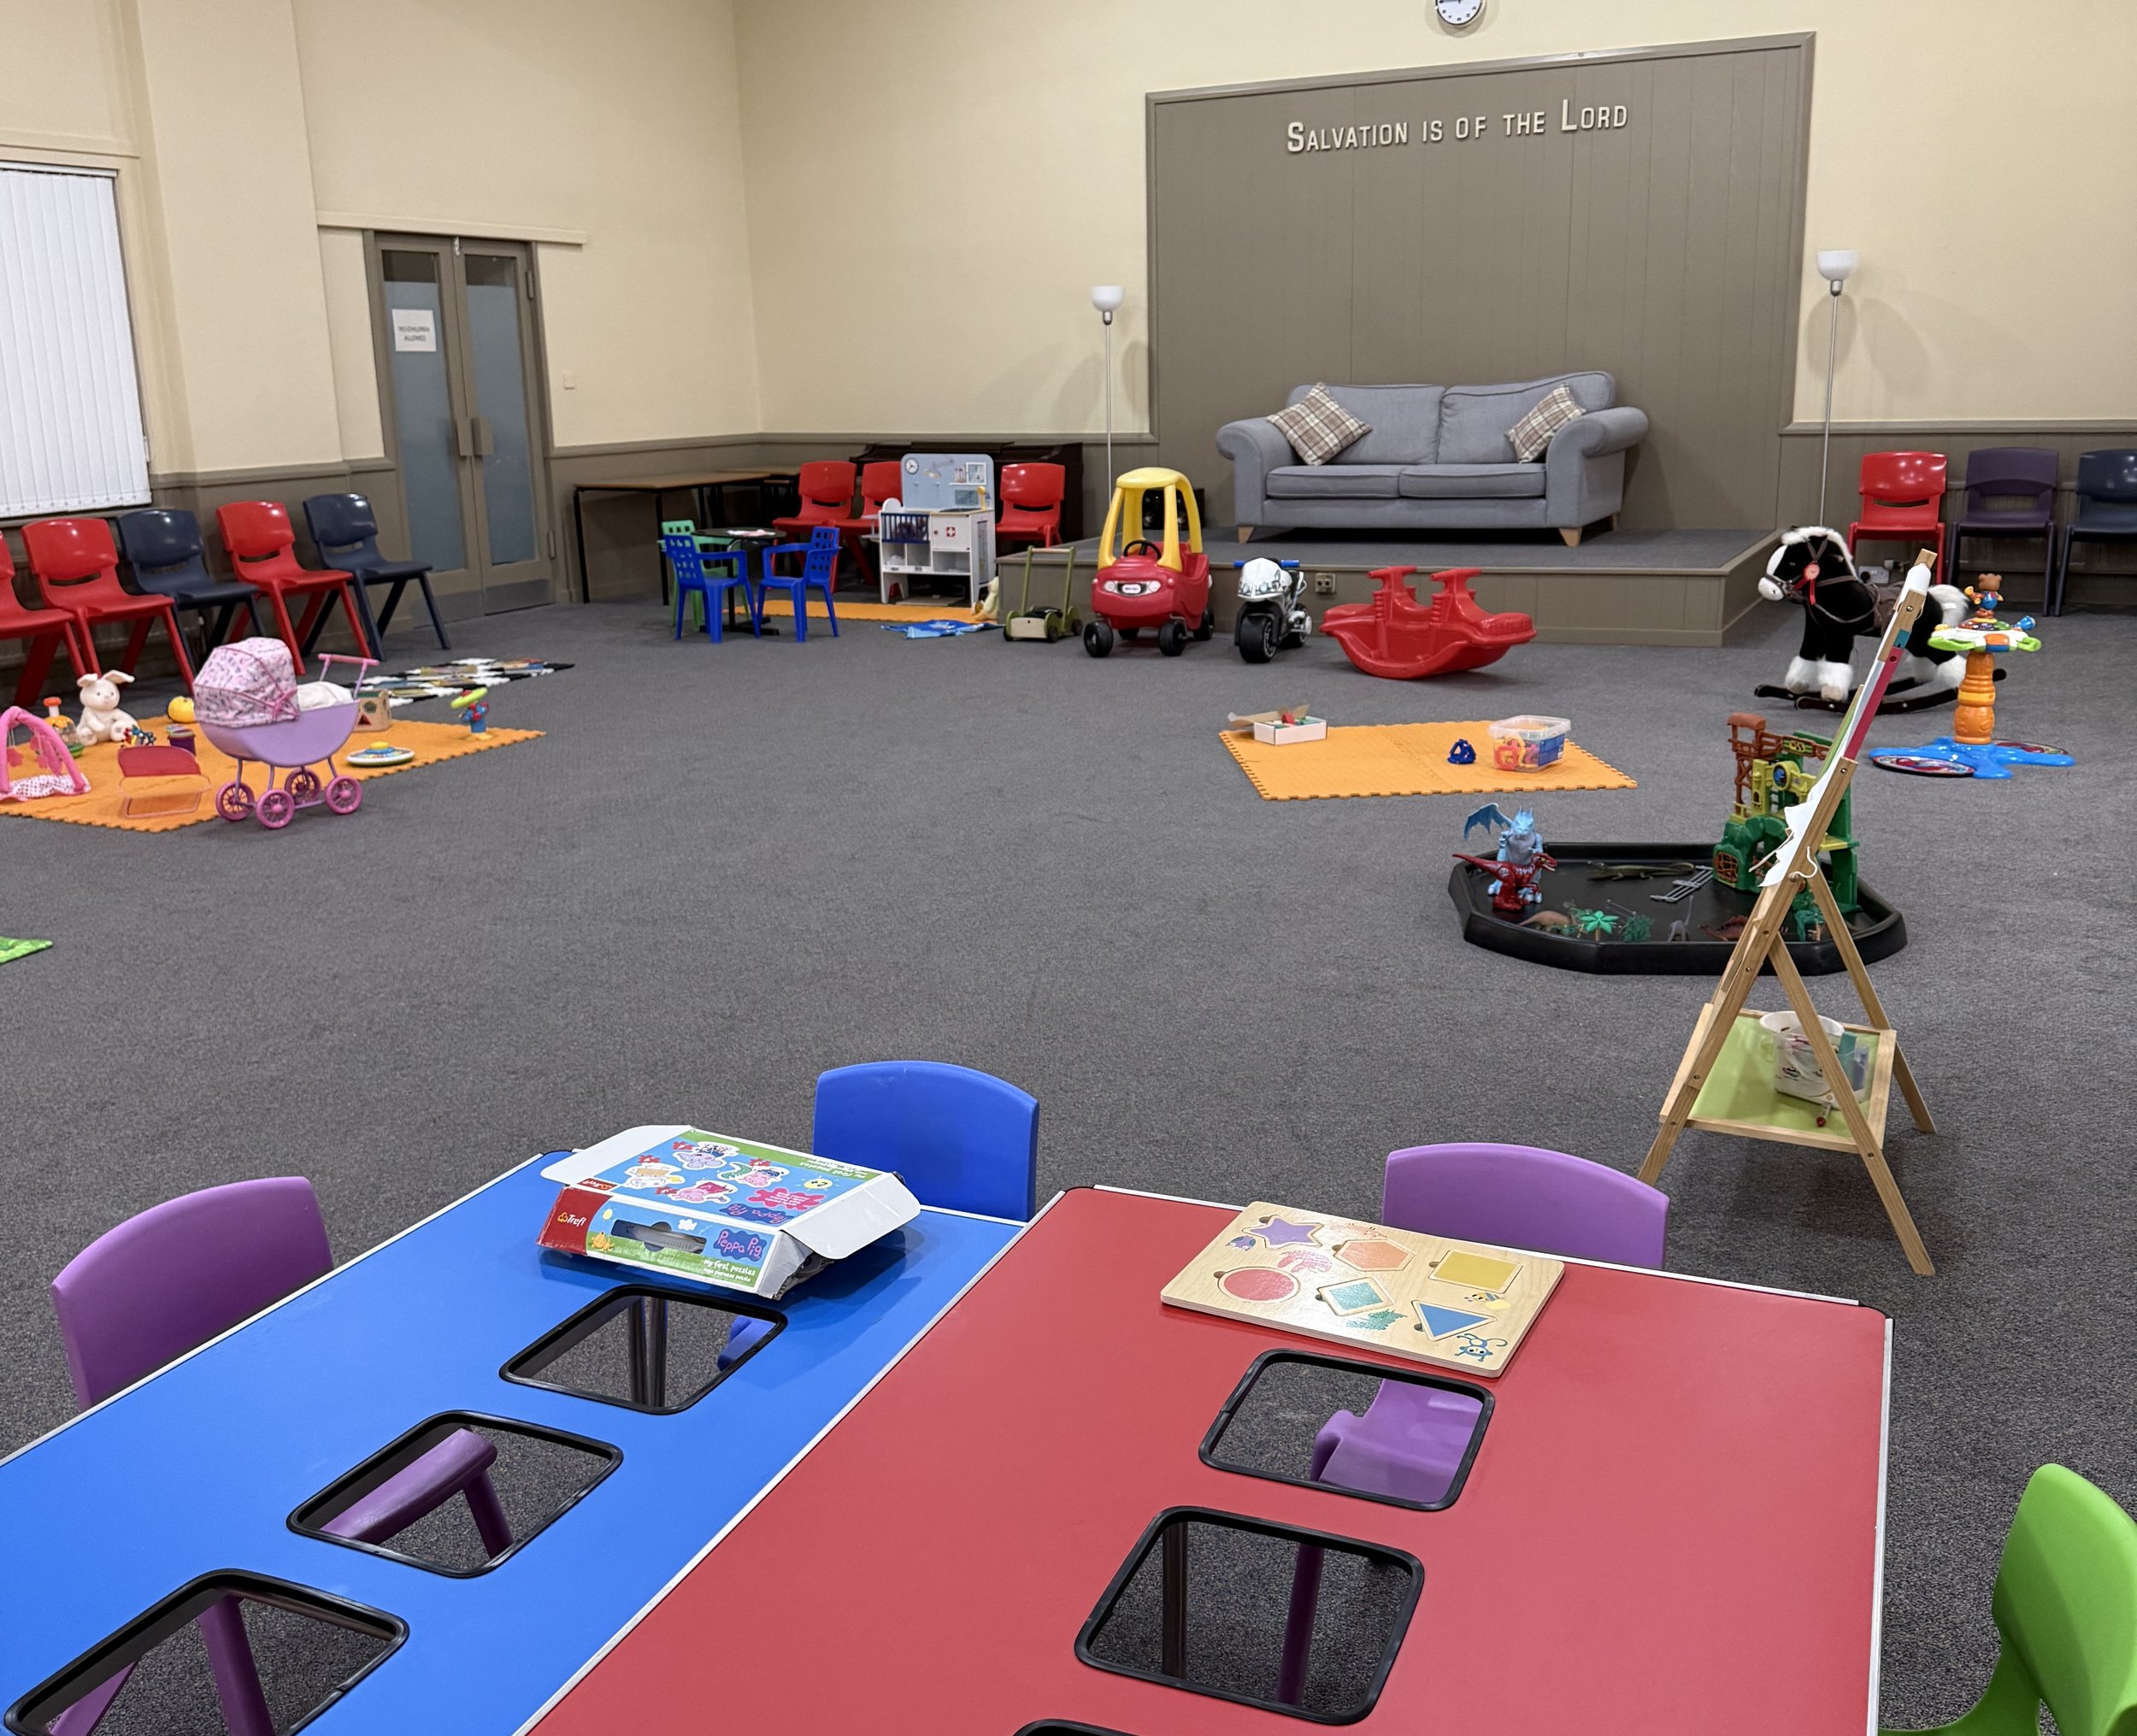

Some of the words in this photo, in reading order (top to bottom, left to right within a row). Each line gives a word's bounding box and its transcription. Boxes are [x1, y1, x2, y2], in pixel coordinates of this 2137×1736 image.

[1422, 120, 1444, 142] IS
[1456, 116, 1487, 138] OF
[1502, 111, 1545, 136] THE
[567, 1214, 587, 1227] Trefl
[752, 1209, 787, 1224] Peppa
[717, 1230, 745, 1253] Peppa
[747, 1237, 762, 1259] Pig
[730, 1264, 756, 1276] puzzles
